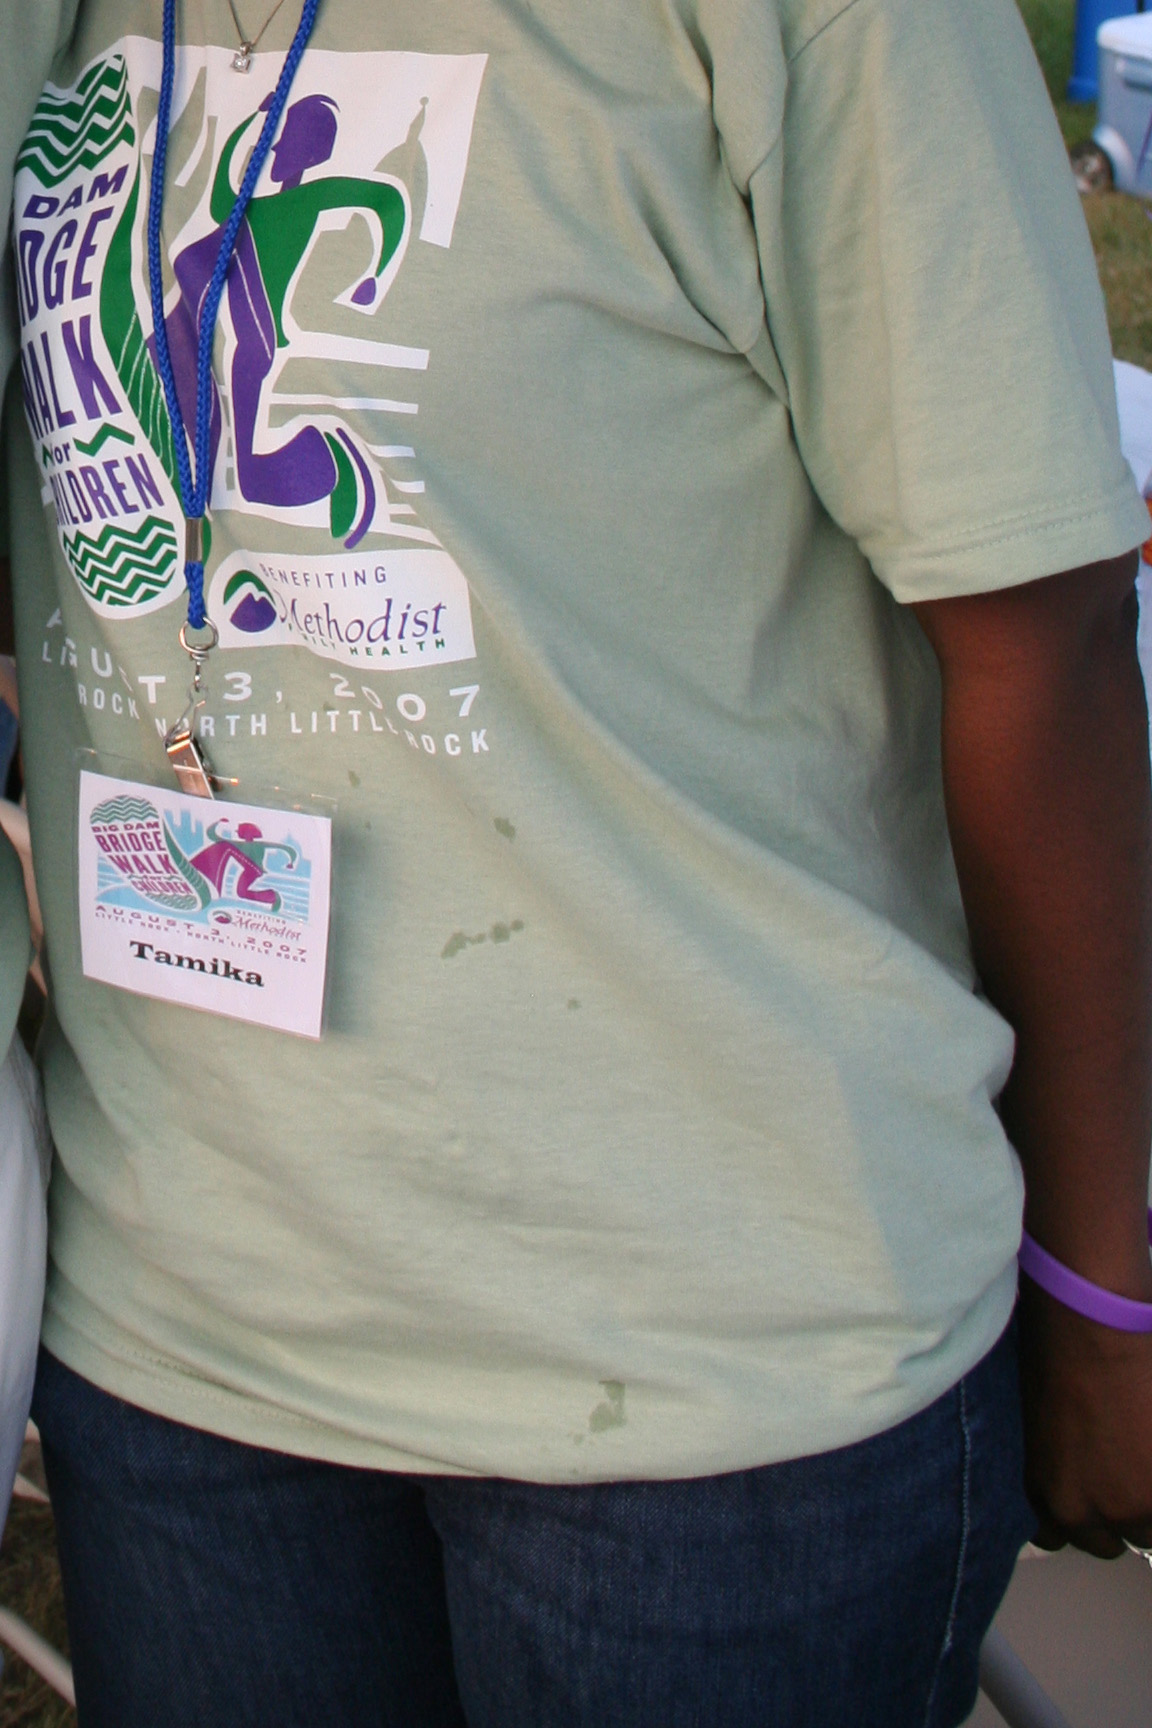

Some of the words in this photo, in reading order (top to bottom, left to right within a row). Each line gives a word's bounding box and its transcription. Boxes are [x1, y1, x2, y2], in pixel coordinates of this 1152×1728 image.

[22, 164, 130, 219] DAM
[259, 562, 387, 589] BENEFITING
[272, 588, 448, 644] Methodist
[349, 638, 446, 656] HEALTH
[77, 683, 141, 719] ROCK
[329, 672, 480, 722] 2007
[91, 824, 119, 833] BIG
[123, 821, 160, 831] DAM
[94, 831, 167, 853] BRIDGE
[107, 853, 179, 875] WALK
[131, 880, 194, 895] CHILDREN
[96, 905, 195, 929] AUGUST
[246, 936, 307, 955] 2007
[231, 914, 302, 941] Methodist
[129, 940, 265, 987] Tamika
